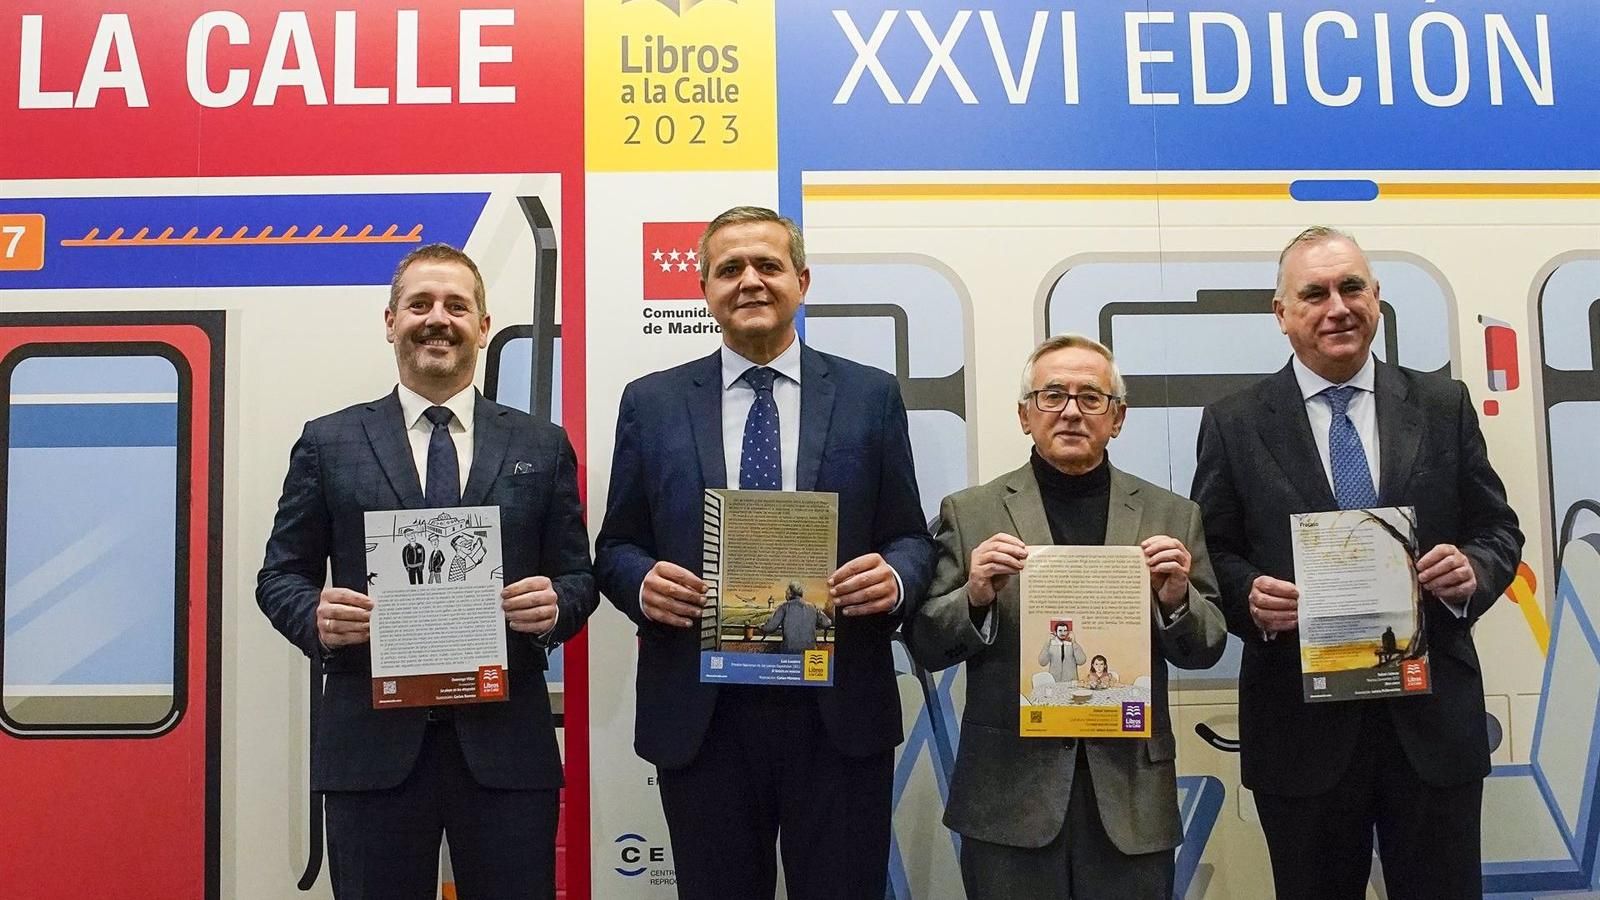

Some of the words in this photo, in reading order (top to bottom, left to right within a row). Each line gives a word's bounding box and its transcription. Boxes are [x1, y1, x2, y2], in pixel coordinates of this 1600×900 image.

[19, 14, 149, 108] LA
[187, 8, 515, 106] CALLE
[621, 35, 739, 73] Libros
[833, 10, 1079, 104] XXVI
[621, 84, 635, 104] a
[644, 77, 666, 104] la
[674, 77, 739, 104] Calle
[624, 115, 739, 144] 2023
[3, 226, 25, 257] 7
[643, 323, 662, 334] de
